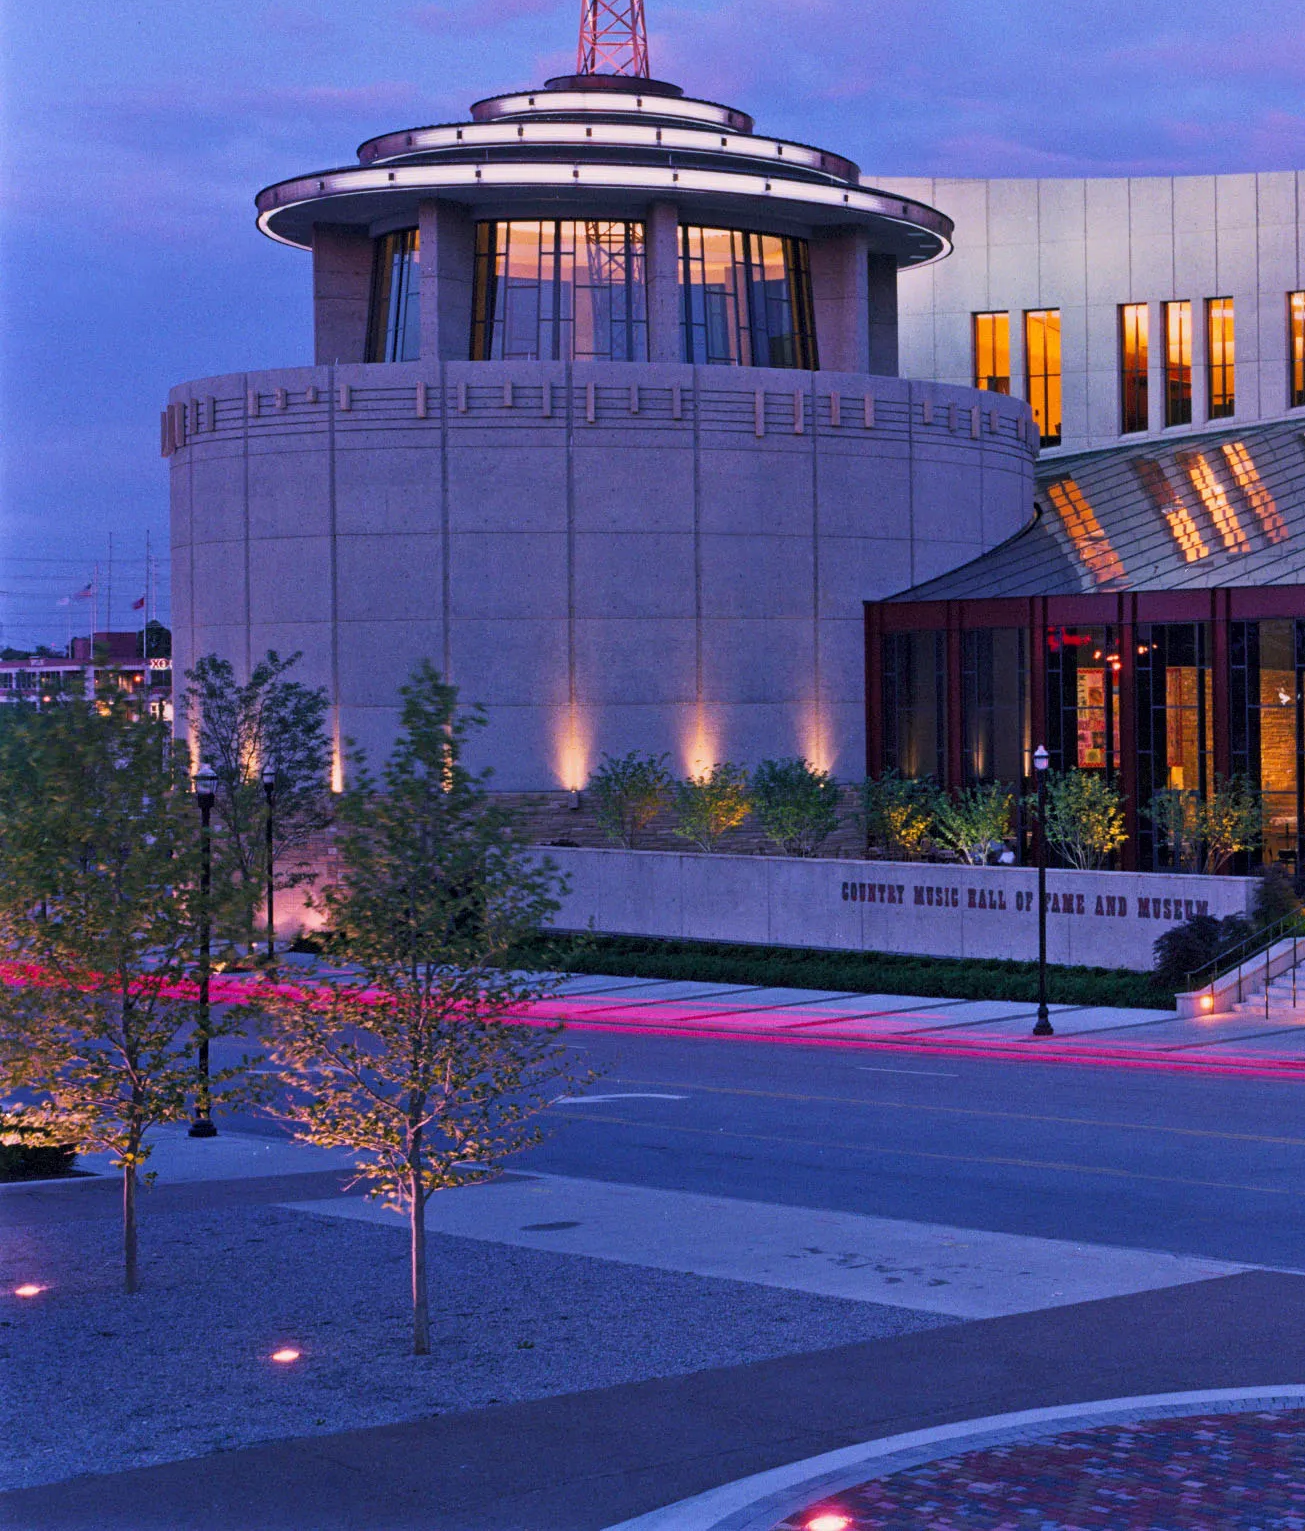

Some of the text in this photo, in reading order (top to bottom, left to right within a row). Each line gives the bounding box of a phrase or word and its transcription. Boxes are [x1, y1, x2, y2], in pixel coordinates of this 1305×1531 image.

[841, 881, 905, 905] COUNTRY
[913, 885, 960, 908] MUSIC
[967, 888, 1007, 911] HALL
[1015, 890, 1034, 912] OF
[1094, 894, 1128, 917] AND
[1137, 897, 1209, 920] MUSEUM
